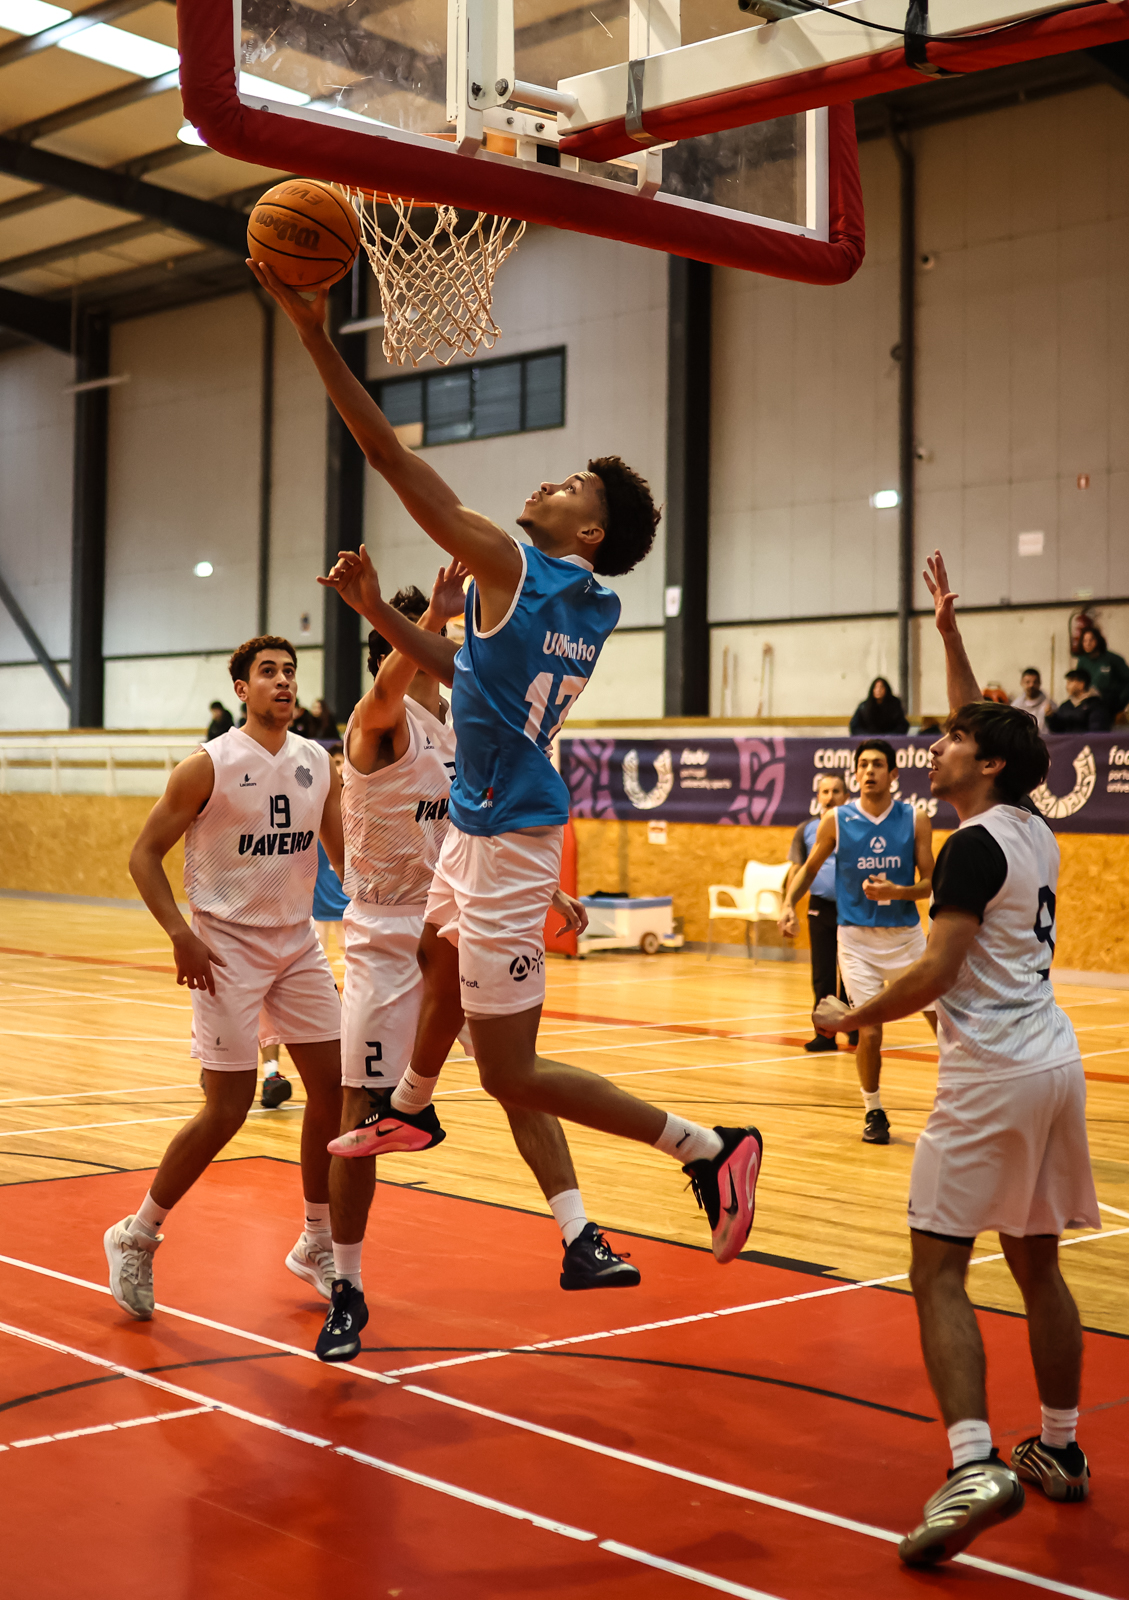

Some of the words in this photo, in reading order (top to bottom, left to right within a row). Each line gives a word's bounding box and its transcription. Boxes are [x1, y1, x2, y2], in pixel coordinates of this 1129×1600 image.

[255, 210, 321, 251] Wilson
[524, 672, 588, 746] 17
[813, 744, 933, 773] campatos
[270, 794, 291, 829] 19
[238, 830, 315, 856] UAVEIRO
[857, 855, 901, 870] aaum
[365, 1041, 384, 1077] 2
